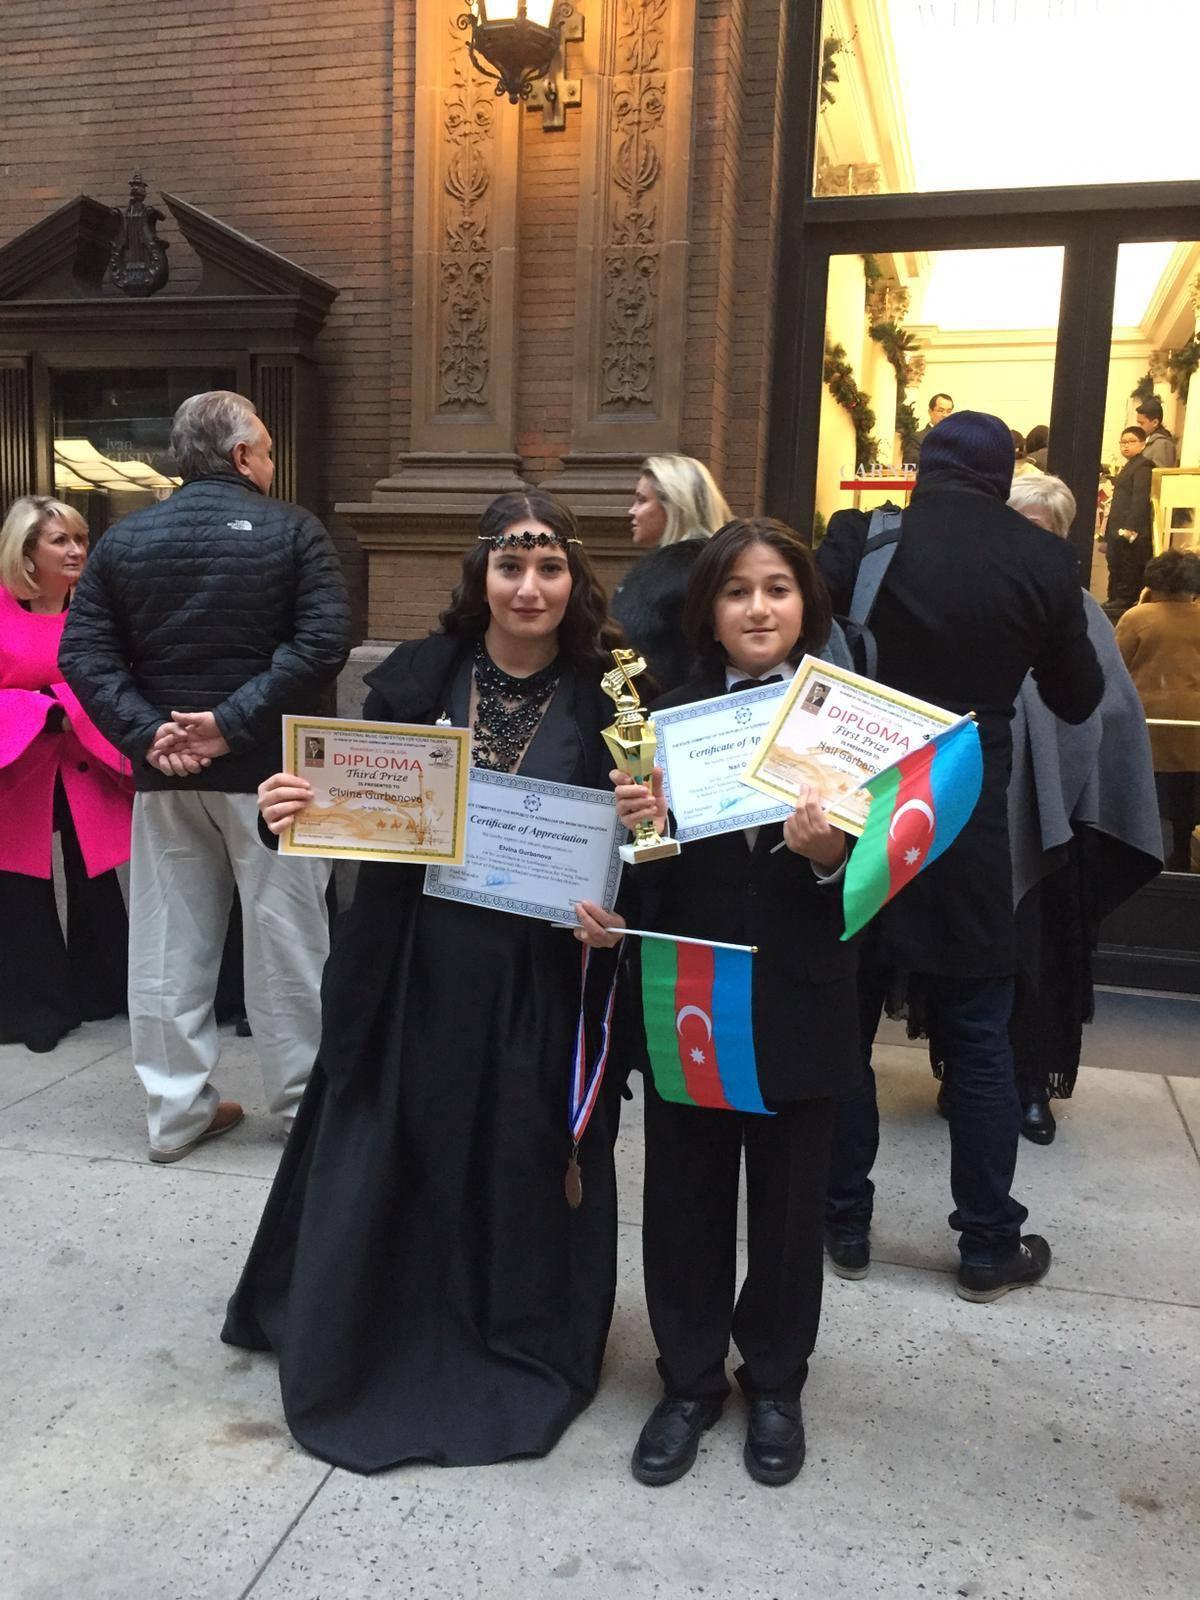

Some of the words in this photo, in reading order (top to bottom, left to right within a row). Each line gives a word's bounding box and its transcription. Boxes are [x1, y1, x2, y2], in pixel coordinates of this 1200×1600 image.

[828, 705, 911, 750] DIPLOMA
[690, 742, 734, 759] Certificate
[737, 738, 747, 749] of
[832, 724, 860, 741] First
[862, 734, 889, 754] Prize
[817, 741, 838, 758] Nail
[333, 753, 423, 772] DIPLOMA
[346, 768, 377, 780] Third
[380, 771, 408, 782] Prize
[329, 787, 362, 798] Elvina
[365, 790, 423, 804] Gurbanova
[470, 814, 516, 832] Certificate
[518, 826, 529, 836] of
[529, 827, 588, 845] Appreciation
[499, 845, 517, 853] Elvina
[519, 849, 552, 860] Gurbanova
